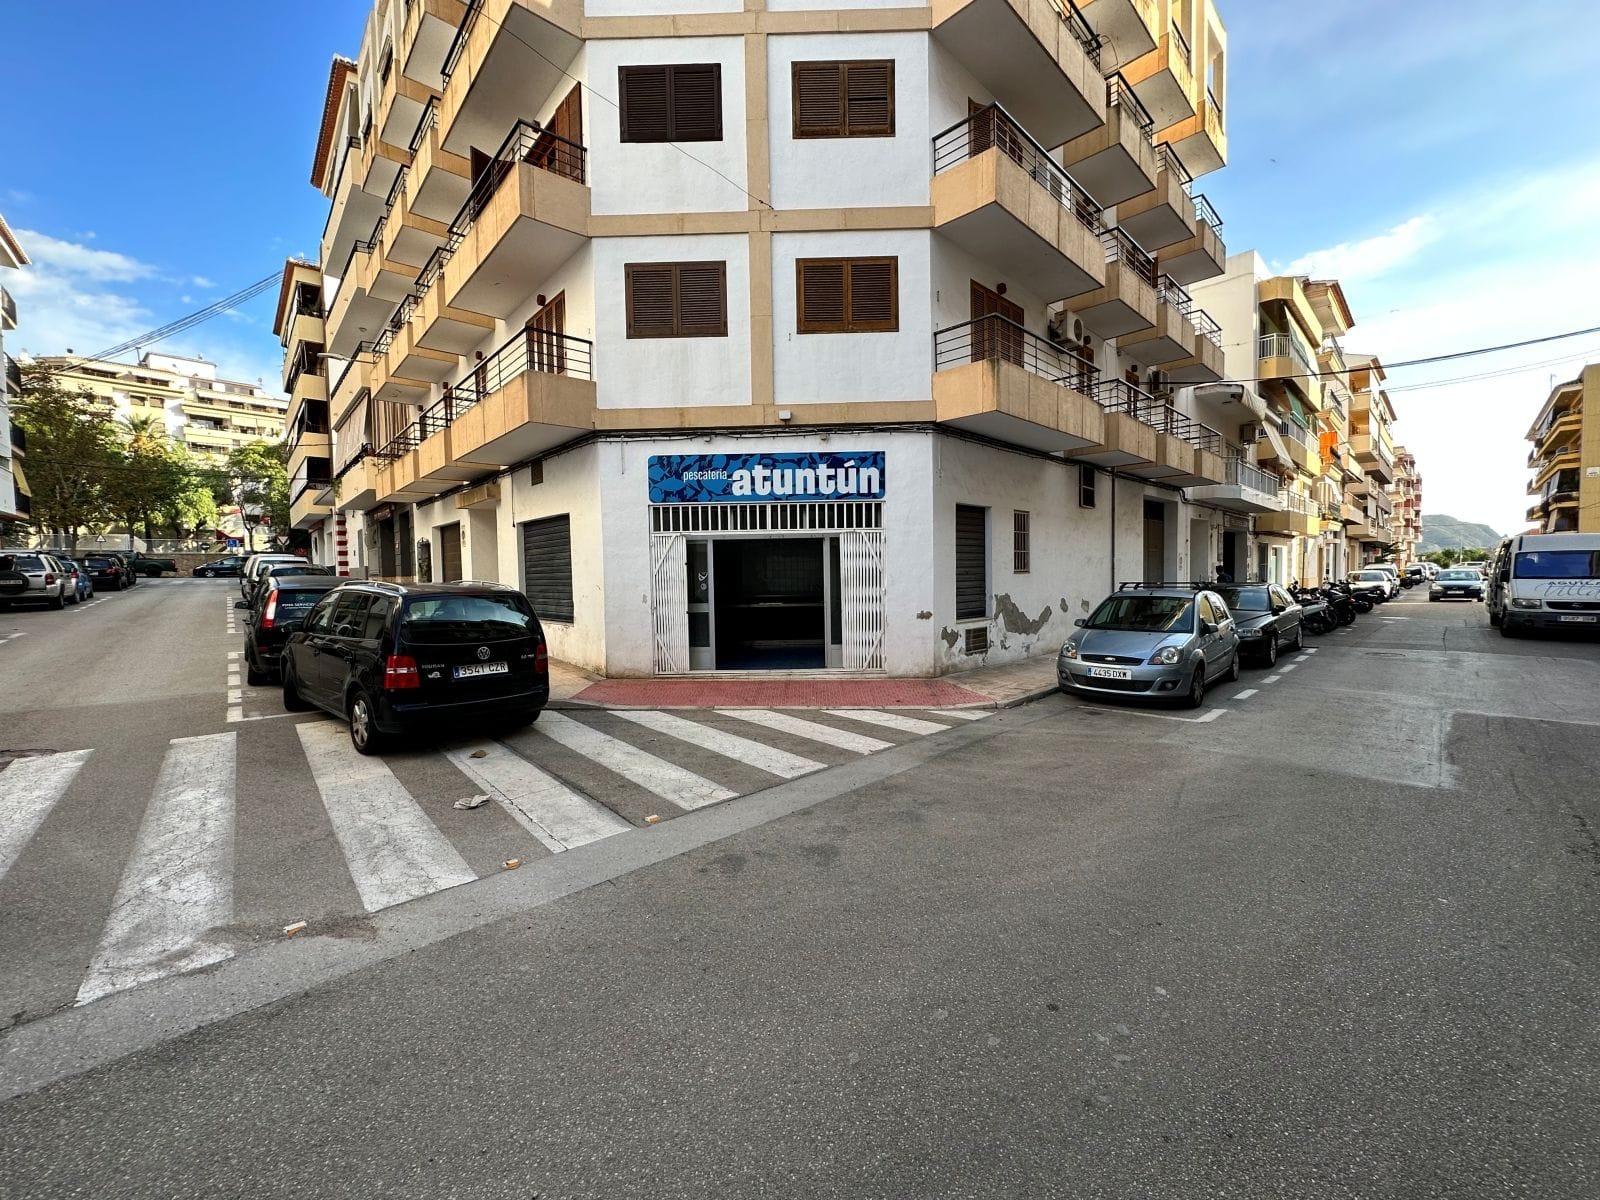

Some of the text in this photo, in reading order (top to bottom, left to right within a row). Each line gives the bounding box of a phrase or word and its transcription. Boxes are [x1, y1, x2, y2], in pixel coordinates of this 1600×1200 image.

[732, 460, 880, 496] atuntún
[461, 662, 506, 676] 3541 CZR
[1093, 669, 1111, 678] 4435
